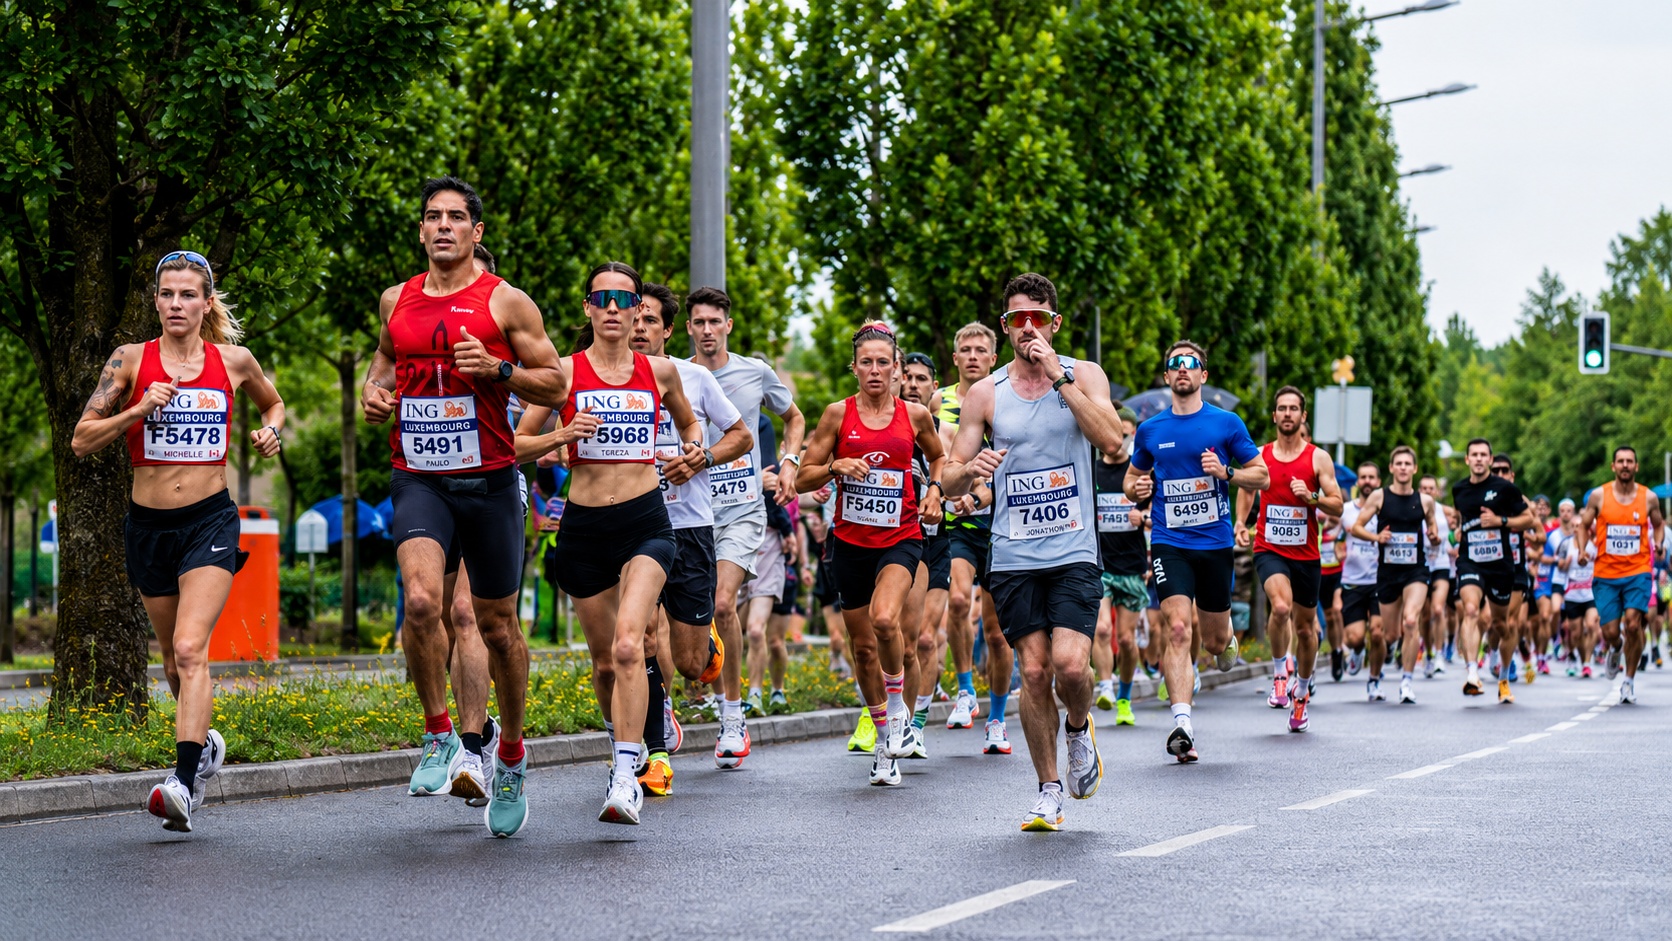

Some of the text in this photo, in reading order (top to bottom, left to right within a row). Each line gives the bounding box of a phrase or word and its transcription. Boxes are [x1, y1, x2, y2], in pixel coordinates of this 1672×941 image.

[583, 395, 620, 409] ING
[406, 403, 438, 418] ING
[147, 413, 222, 423] LXEMBOURG
[593, 413, 650, 423] XEMBOURG
[405, 422, 471, 432] LUXEMBOURG
[147, 426, 220, 445] F5478
[413, 435, 463, 455] 5491
[164, 450, 203, 459] MICHELLE
[426, 459, 450, 467] PAULO
[710, 480, 747, 498] 3479
[1012, 475, 1045, 493] ING
[1167, 482, 1191, 494] ING
[1012, 489, 1073, 505] LUXEMBOURG
[1098, 496, 1117, 506] ING
[846, 495, 897, 514] F5450
[1173, 501, 1209, 517] 6499
[1019, 502, 1070, 525] 7406
[1270, 507, 1290, 518] ING
[1272, 525, 1300, 537] 9083
